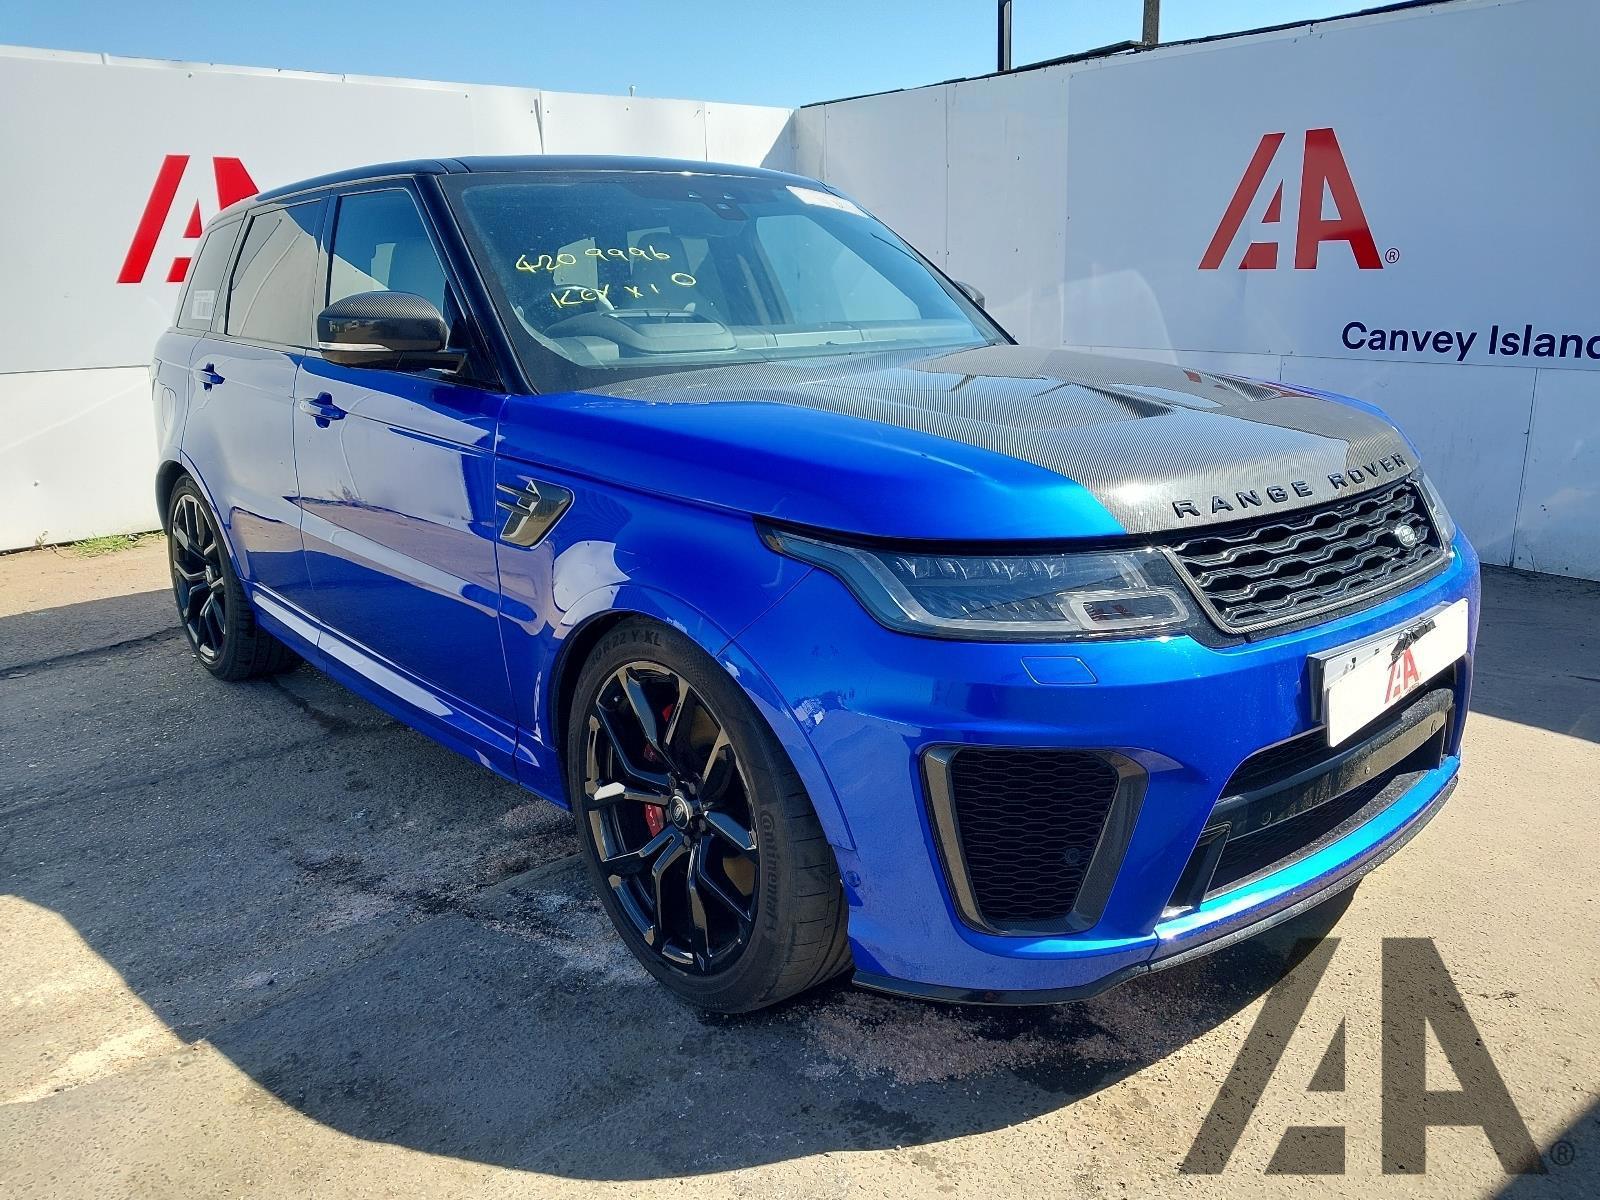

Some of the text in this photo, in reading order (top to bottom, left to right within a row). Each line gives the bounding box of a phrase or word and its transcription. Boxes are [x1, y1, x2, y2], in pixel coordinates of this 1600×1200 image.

[1198, 128, 1384, 270] AA
[515, 245, 671, 273] 420 9996
[1341, 321, 1477, 362] Canvey
[1172, 452, 1408, 519] RANGE ROVER
[759, 810, 780, 919] Continental
